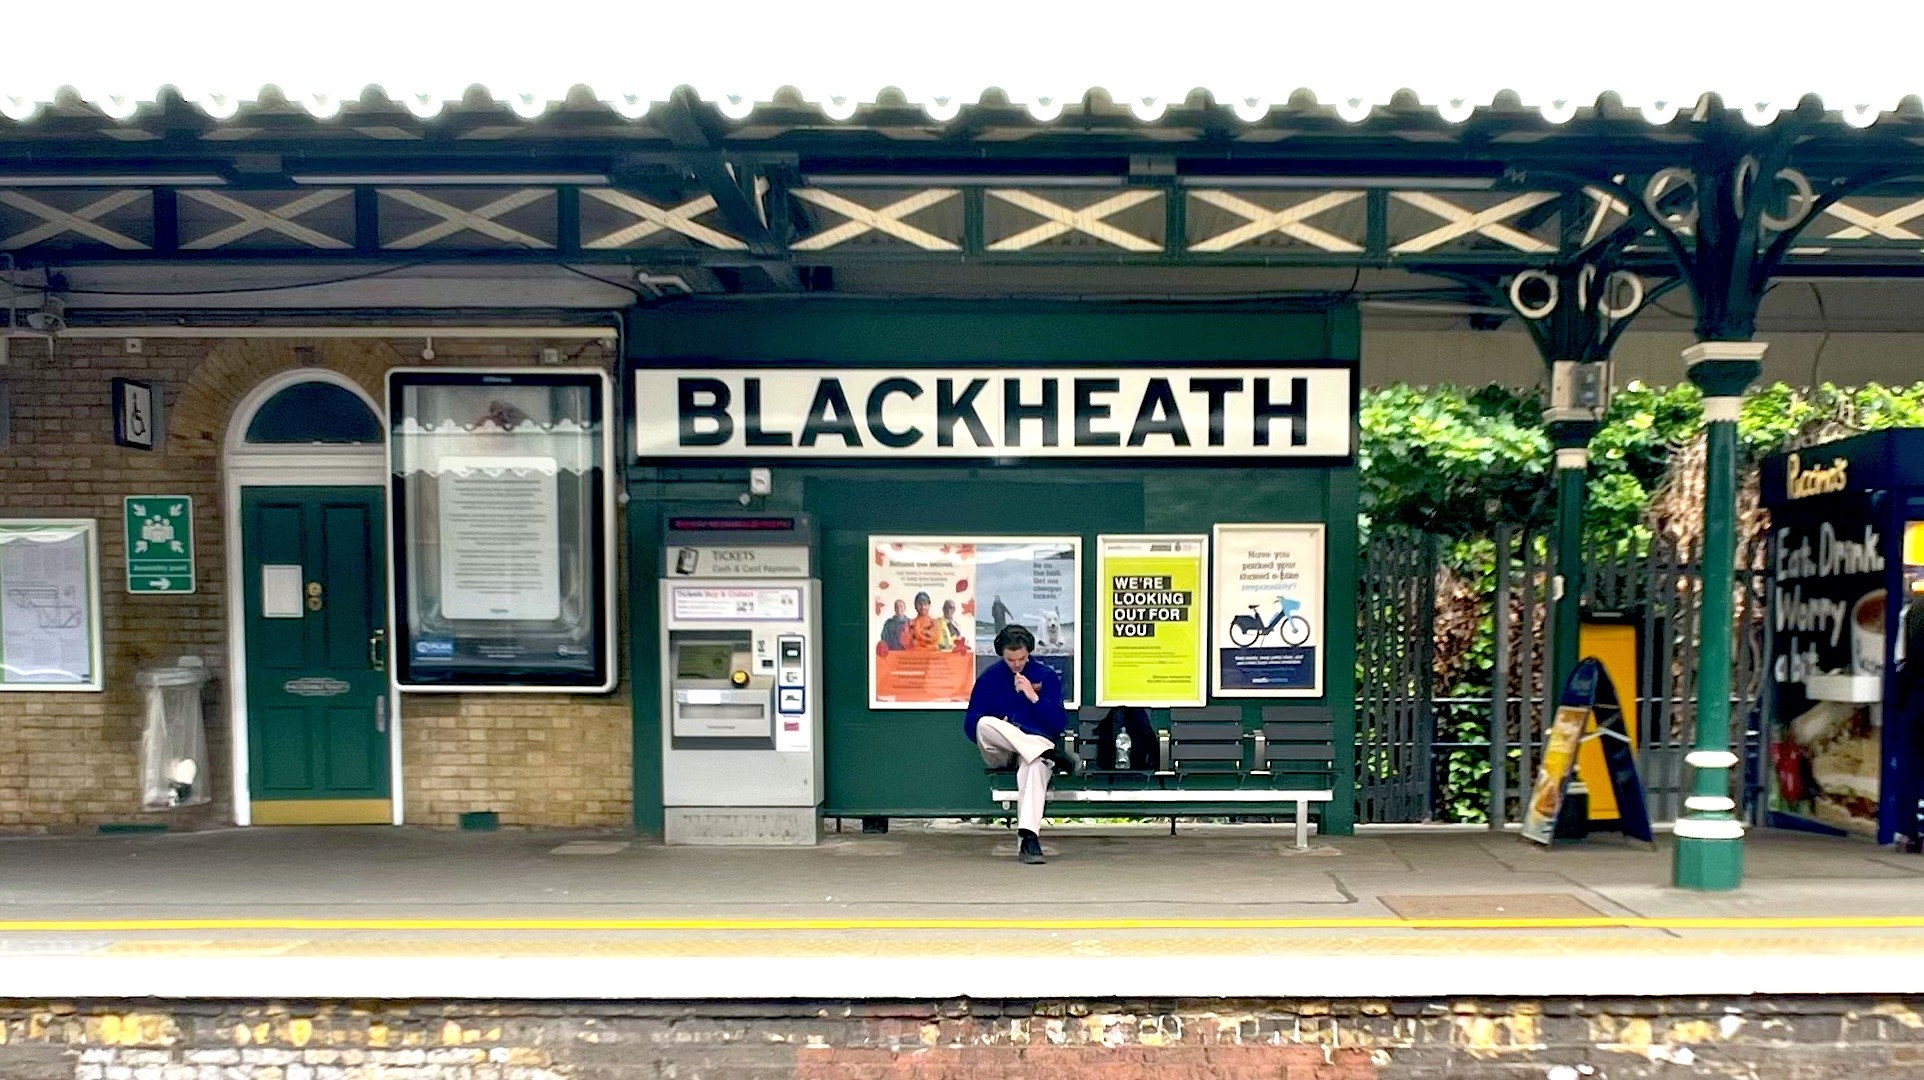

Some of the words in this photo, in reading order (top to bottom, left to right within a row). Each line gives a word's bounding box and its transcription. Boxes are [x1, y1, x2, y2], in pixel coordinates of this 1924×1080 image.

[678, 377, 1309, 449] BLACKHEATH
[712, 550, 756, 561] TICKETS
[1777, 527, 1817, 581] Eat.
[1819, 521, 1885, 577] Drink.
[712, 565, 732, 573] Cash
[742, 565, 761, 573] Card
[1242, 562, 1274, 571] parked
[1114, 577, 1163, 589] WE'RE
[1114, 593, 1184, 605] LOOKING
[1114, 609, 1146, 621] OUT
[1149, 609, 1180, 621] FOR
[1775, 584, 1847, 648] Worry
[1114, 624, 1147, 636] YOU
[1774, 654, 1788, 682] a
